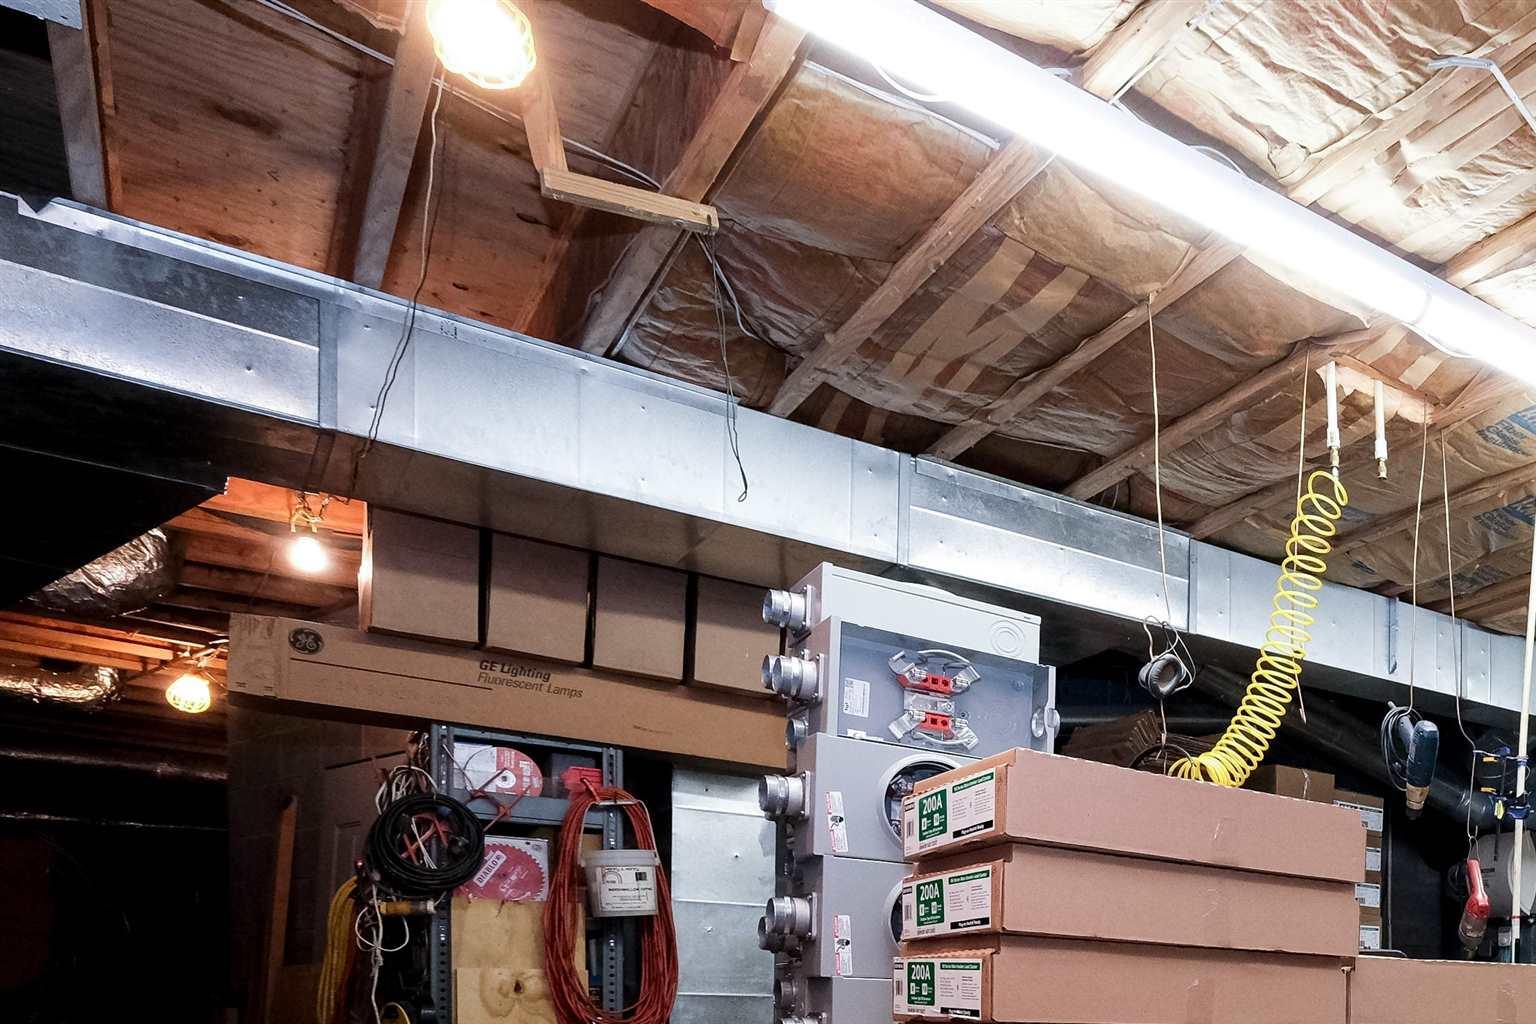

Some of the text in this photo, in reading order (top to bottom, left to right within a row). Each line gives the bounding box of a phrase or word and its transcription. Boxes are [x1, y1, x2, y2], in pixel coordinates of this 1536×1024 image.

[479, 660, 551, 682] GE Lighting
[477, 672, 584, 699] Fluorescent Lamps
[923, 793, 942, 815] 200A
[920, 883, 939, 900] 200A
[911, 964, 931, 980] 200A
